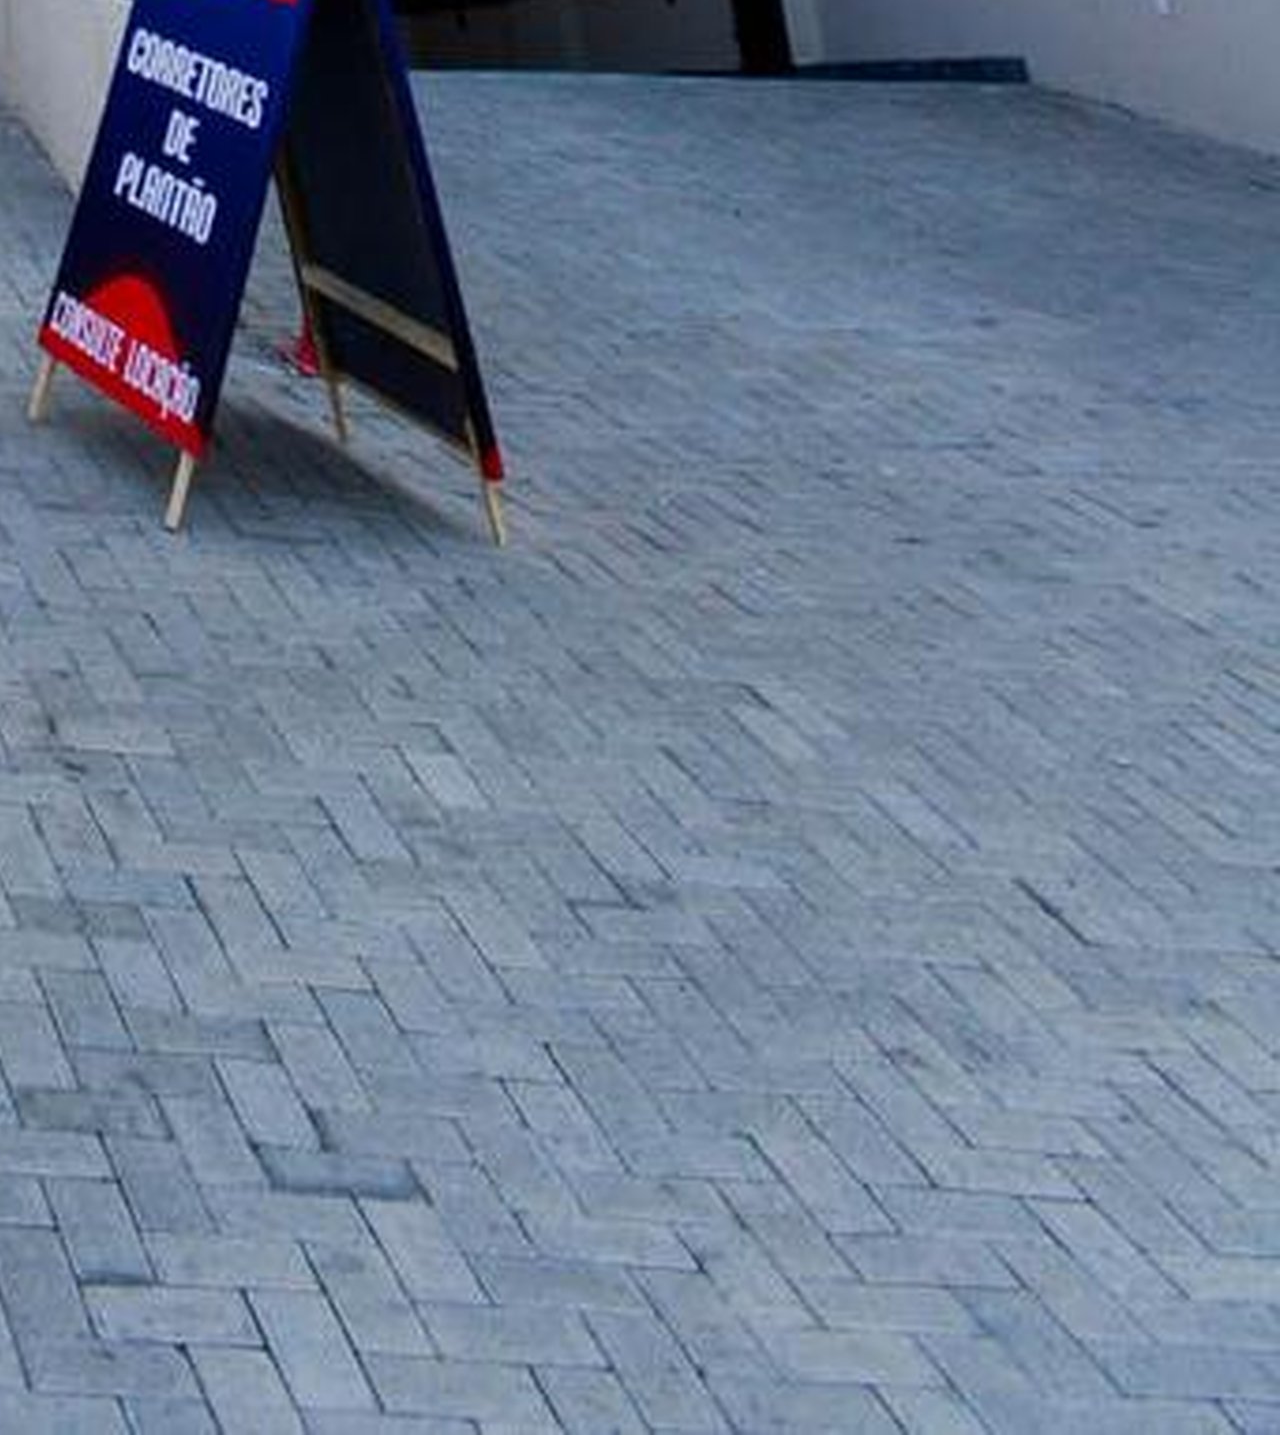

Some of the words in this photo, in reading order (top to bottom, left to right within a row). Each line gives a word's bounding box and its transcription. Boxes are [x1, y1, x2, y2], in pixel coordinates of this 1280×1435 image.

[128, 28, 269, 128] CORRETORES
[163, 109, 200, 164] DE
[114, 152, 218, 245] PLANTÃO
